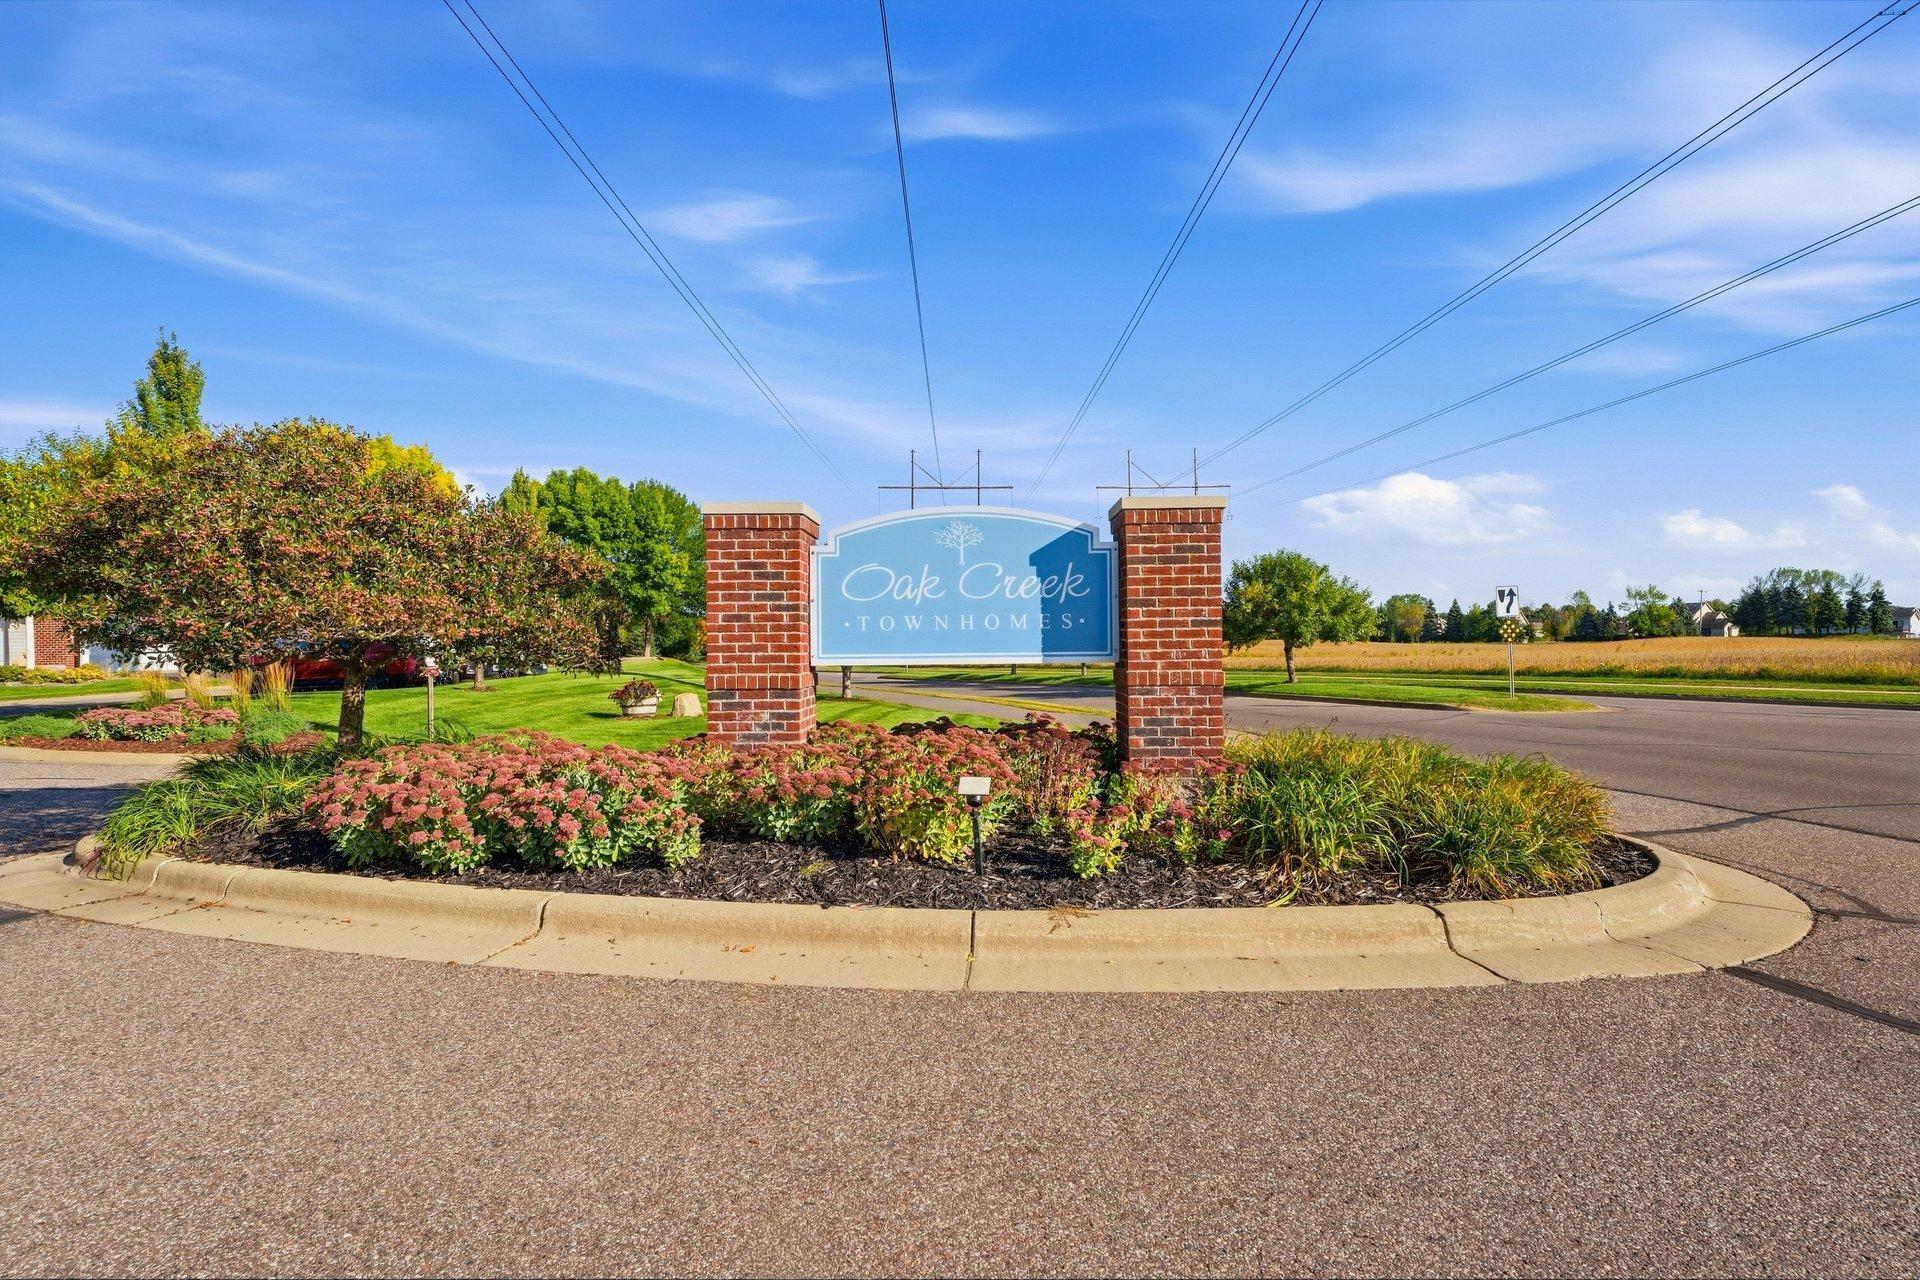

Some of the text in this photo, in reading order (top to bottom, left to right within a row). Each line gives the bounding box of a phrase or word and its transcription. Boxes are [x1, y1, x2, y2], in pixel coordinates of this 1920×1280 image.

[842, 562, 1090, 605] Oak Creek
[857, 613, 1073, 632] TOWNHOMES
